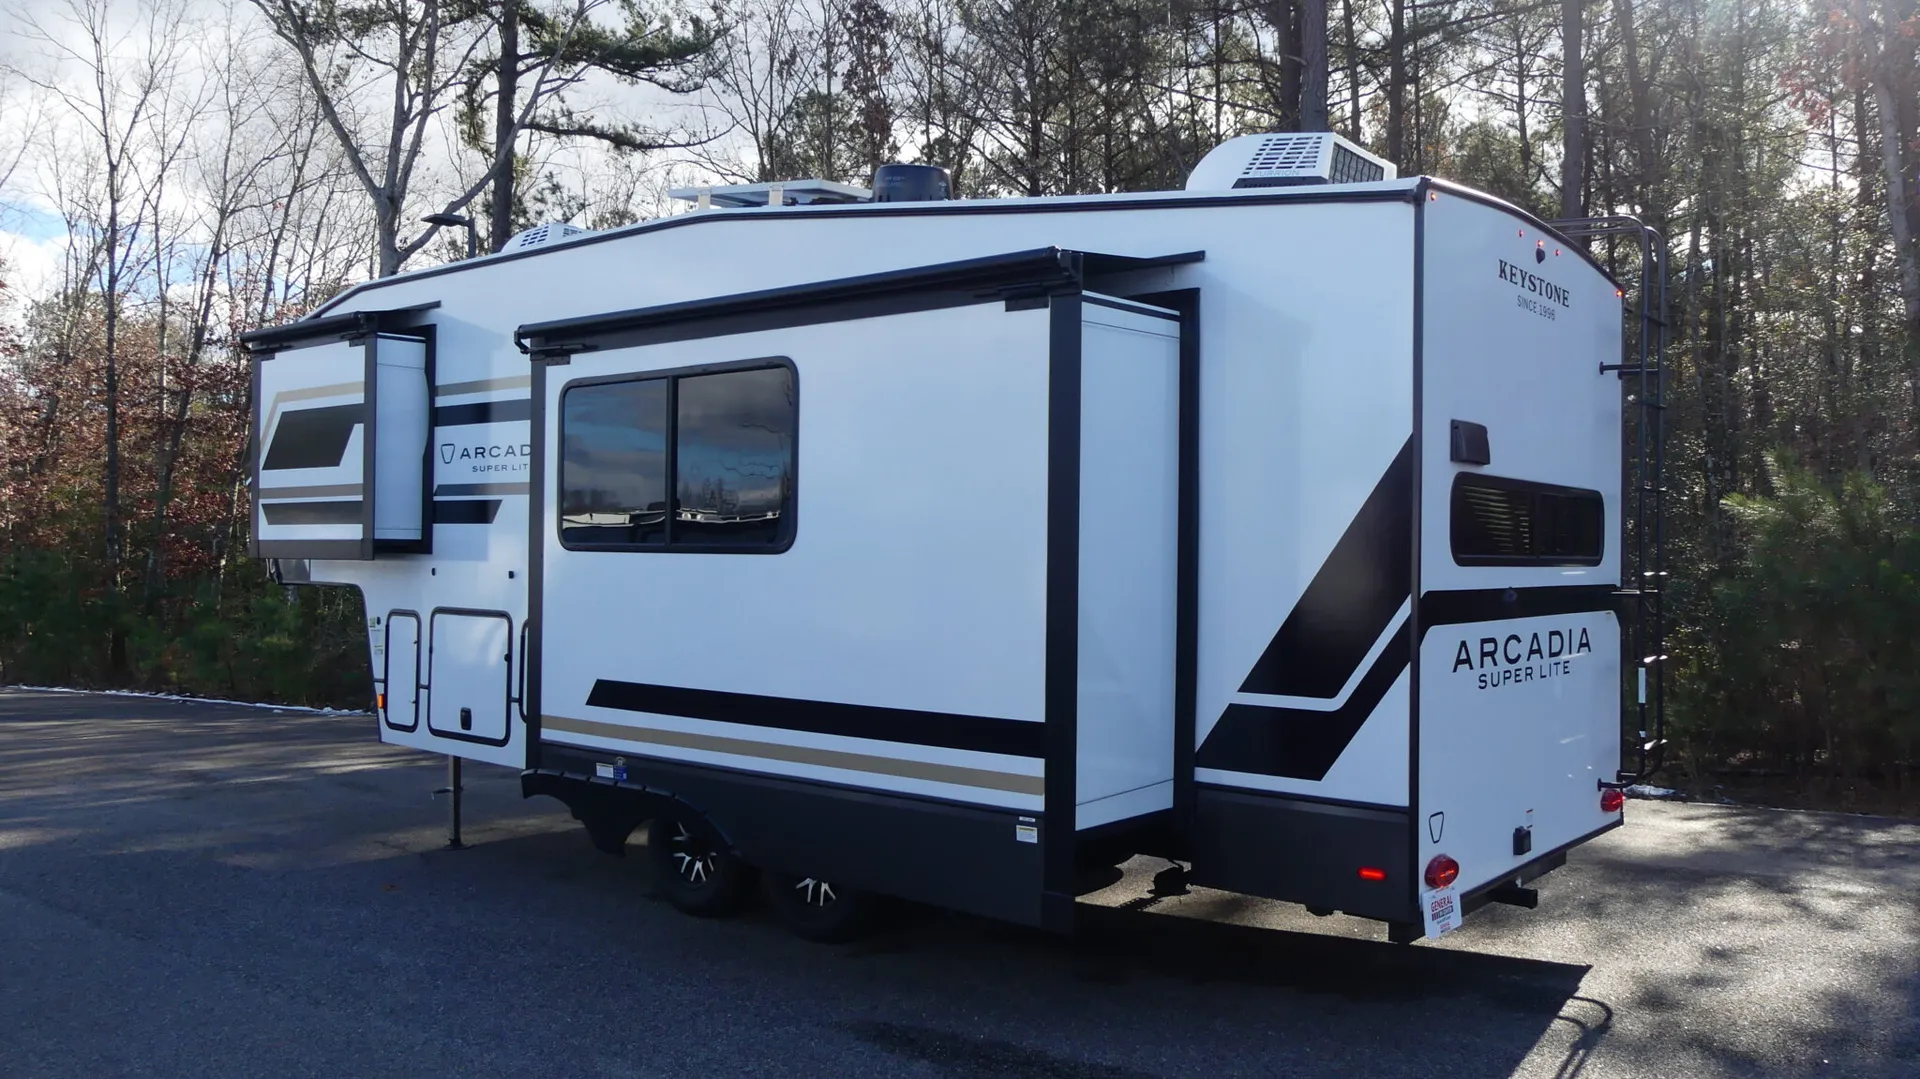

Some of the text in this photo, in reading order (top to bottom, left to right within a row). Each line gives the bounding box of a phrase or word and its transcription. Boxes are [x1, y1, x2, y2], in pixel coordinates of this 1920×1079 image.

[1499, 259, 1570, 308] KEYSTONE
[1517, 294, 1537, 314] SINCE
[1452, 627, 1592, 674] ARCADIA
[1477, 660, 1571, 690] SUPER LITE
